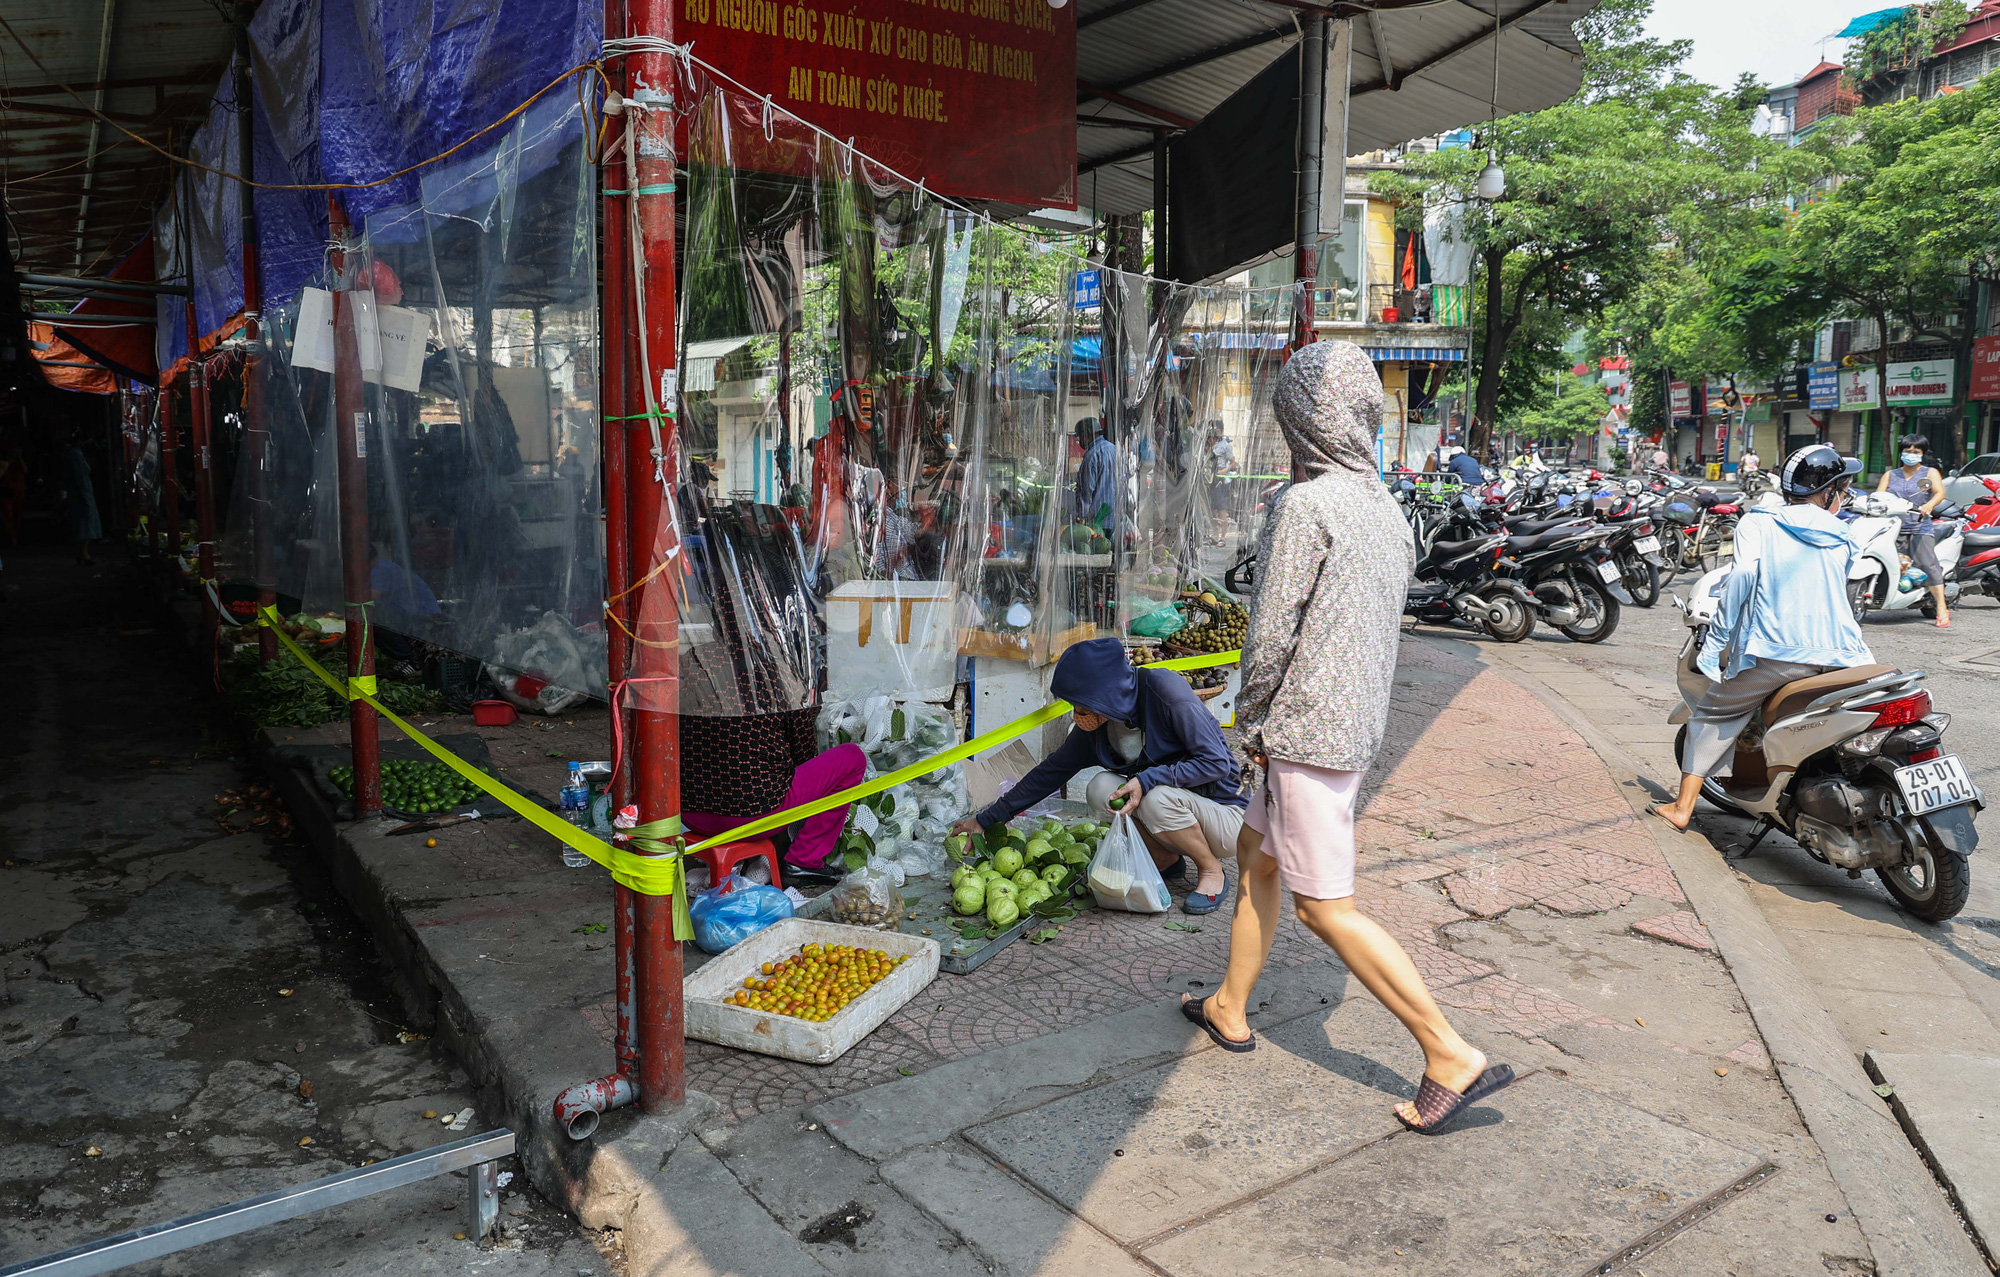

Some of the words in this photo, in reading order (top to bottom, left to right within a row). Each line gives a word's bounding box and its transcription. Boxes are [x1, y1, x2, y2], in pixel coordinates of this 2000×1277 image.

[822, 5, 866, 51] XUẤT
[869, 16, 894, 56] XỨ
[896, 26, 928, 63] CHO
[932, 29, 963, 70] BỮA
[967, 33, 989, 73] ĂN
[993, 45, 1037, 86] NGON,
[788, 66, 811, 103] AN
[818, 68, 861, 110] TOÀN
[866, 73, 898, 115] SỨC
[903, 78, 949, 123] KHỎE.
[1886, 385, 1911, 396] LAPTOP
[1912, 383, 1946, 395] BUSINESS
[1905, 760, 1956, 789] 29-D1
[1909, 779, 1971, 811] 707.04
